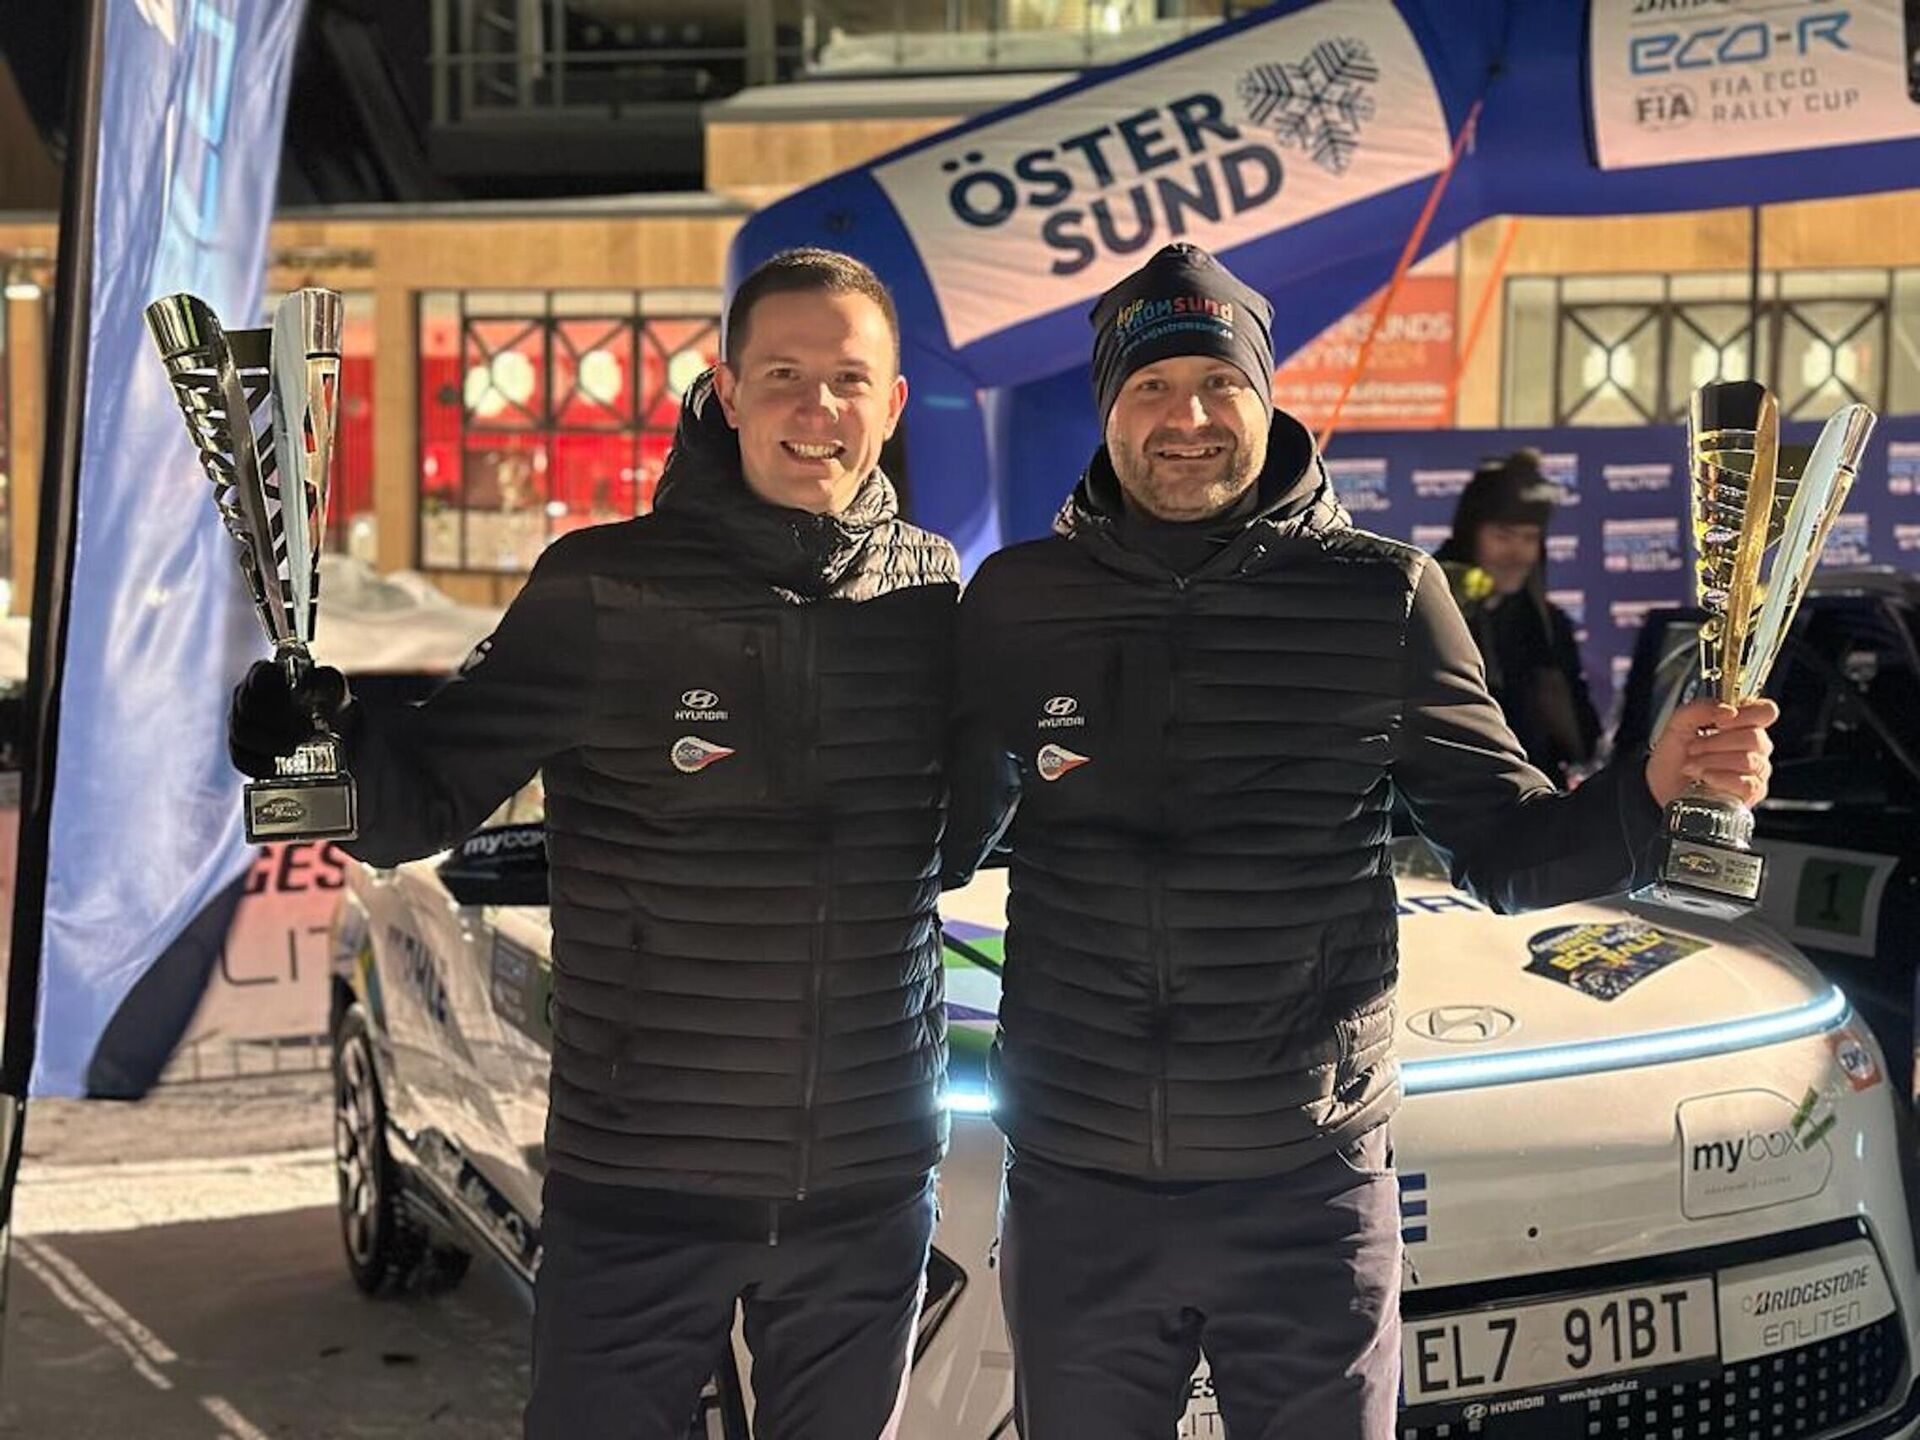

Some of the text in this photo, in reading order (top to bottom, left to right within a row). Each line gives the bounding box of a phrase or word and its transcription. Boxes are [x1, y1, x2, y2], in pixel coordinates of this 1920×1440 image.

[1709, 67, 1817, 98] FIA ECO
[1711, 89, 1860, 122] RALLY CUP
[941, 93, 1240, 227] ÖSTER
[1041, 144, 1284, 276] SUND
[675, 710, 729, 721] HYUNDAI
[1038, 716, 1085, 729] HYUNDAI
[1817, 871, 1842, 922] 1
[1693, 1129, 1800, 1173] mybox
[1753, 1265, 1872, 1316] BRIDGESTONE
[1416, 1290, 1688, 1394] EL7 91BT
[1763, 1300, 1861, 1348] ENLITEN
[1489, 1395, 1545, 1416] HYUNDAI
[1558, 1379, 1639, 1403] www.hyundai.cz
